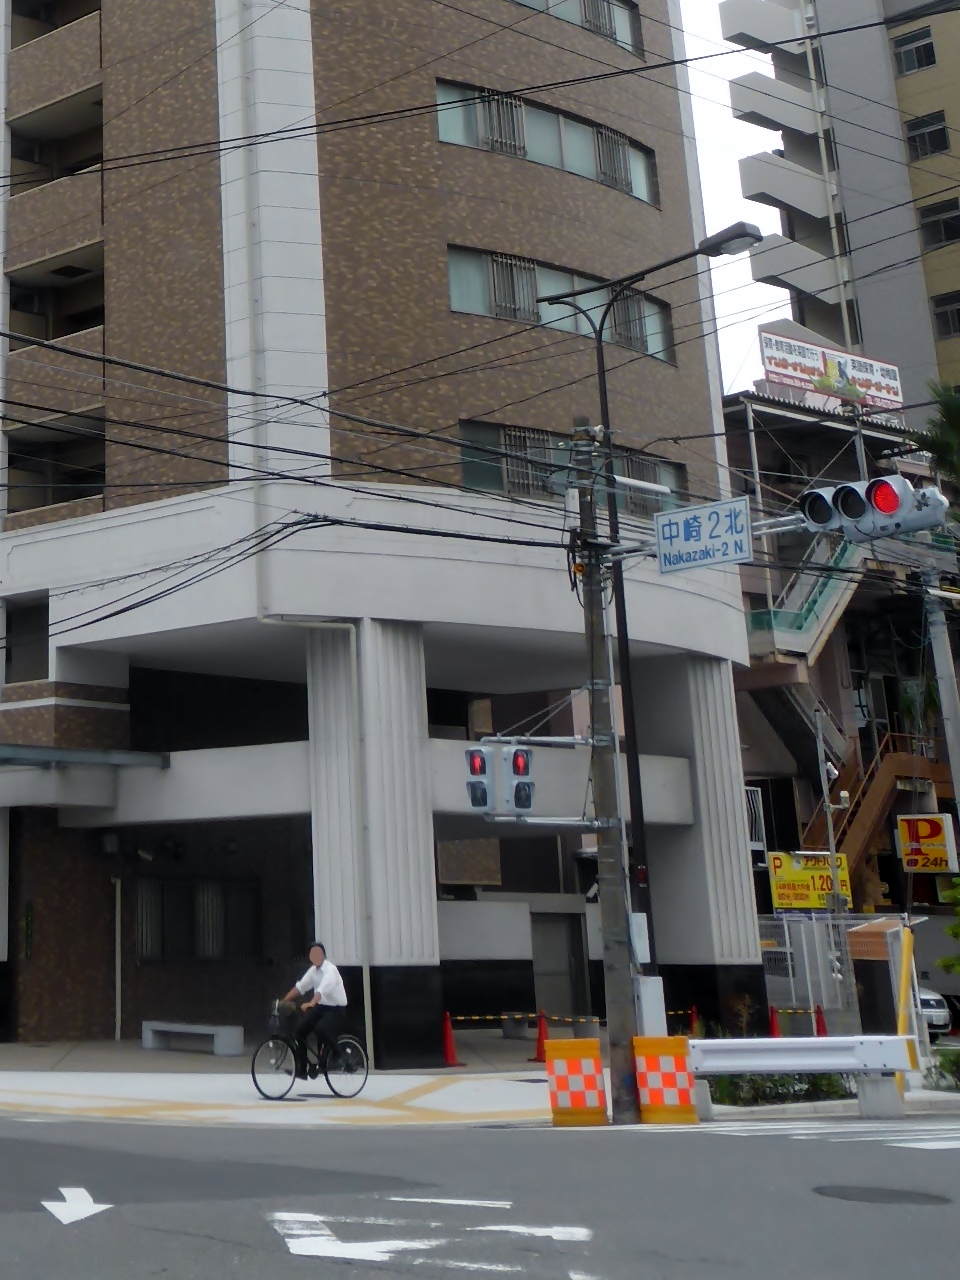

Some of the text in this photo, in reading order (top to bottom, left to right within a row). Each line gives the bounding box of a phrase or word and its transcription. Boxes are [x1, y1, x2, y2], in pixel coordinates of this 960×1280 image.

[661, 507, 744, 546] 中崎2北
[663, 541, 729, 567] Nakazaki-2
[901, 819, 943, 856] P
[772, 856, 783, 876] P
[920, 856, 948, 868] 24h
